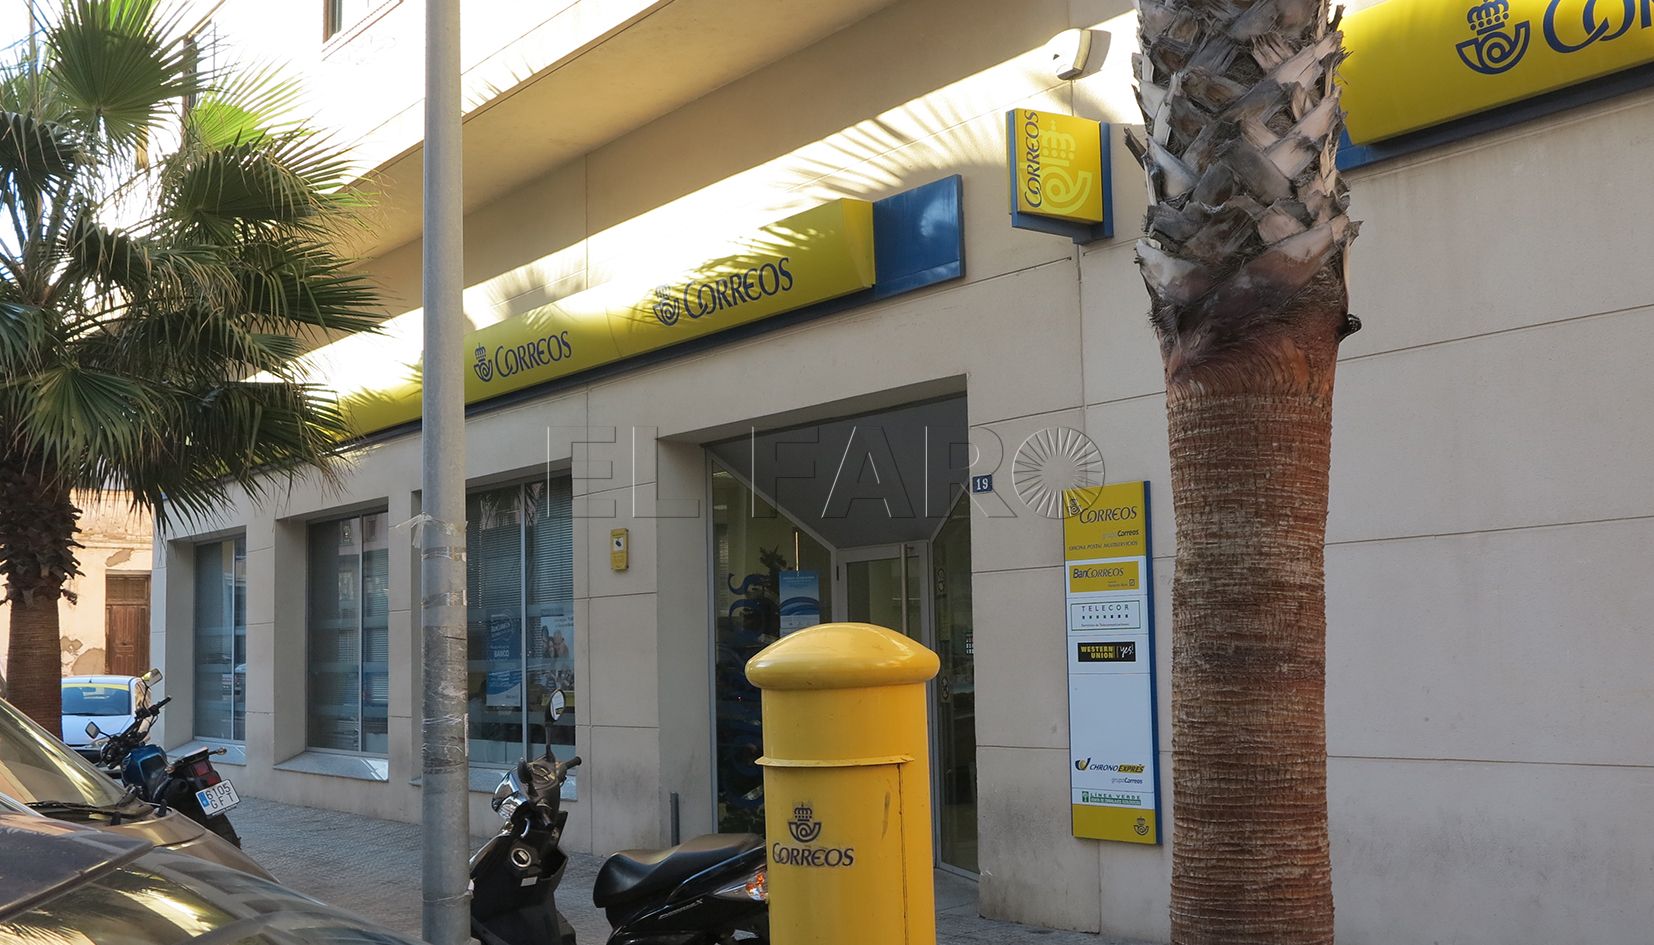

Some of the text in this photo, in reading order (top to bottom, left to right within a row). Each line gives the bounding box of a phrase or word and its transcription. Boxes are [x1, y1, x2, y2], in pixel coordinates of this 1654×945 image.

[1024, 110, 1043, 208] CORREOS
[684, 257, 794, 319] CORREOS
[495, 331, 572, 378] CORREOS
[976, 478, 989, 490] 19
[1080, 506, 1137, 524] CORREOS
[1082, 604, 1129, 612] TELECOR
[206, 784, 231, 800] 6105
[772, 842, 855, 867] CORREOS
